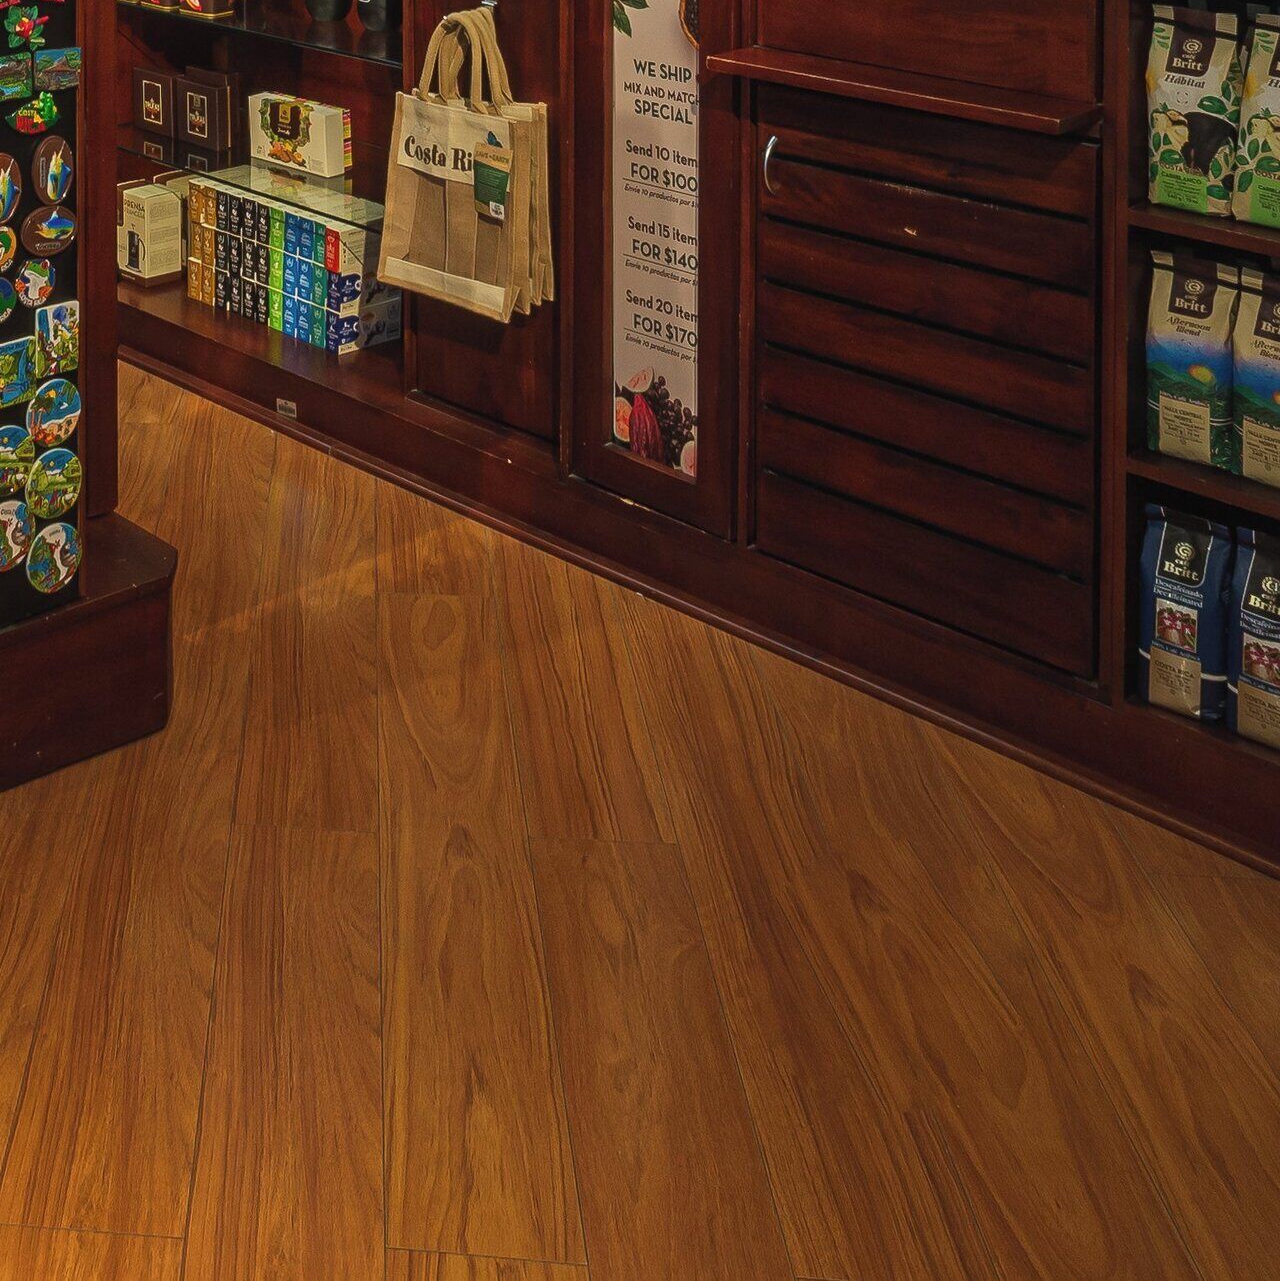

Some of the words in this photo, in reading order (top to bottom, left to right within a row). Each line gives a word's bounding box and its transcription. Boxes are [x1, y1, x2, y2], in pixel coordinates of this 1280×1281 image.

[634, 59, 656, 78] WE
[659, 64, 692, 83] SHIP
[624, 81, 642, 95] MIX
[644, 85, 665, 99] AND
[634, 99, 693, 125] SPECIAL
[405, 135, 446, 167] Costa
[451, 147, 473, 172] Ri
[625, 140, 653, 158] Send
[655, 145, 669, 160] 10
[672, 149, 697, 168] item
[631, 163, 659, 184] FOR
[662, 170, 698, 193] $100
[628, 216, 655, 235] Send
[658, 223, 670, 238] 15
[672, 227, 697, 245] item
[632, 239, 661, 260] FOR
[664, 246, 698, 270] $140
[625, 290, 653, 309] Send
[656, 298, 672, 315] 20
[675, 302, 698, 322] item
[633, 314, 661, 336] FOR
